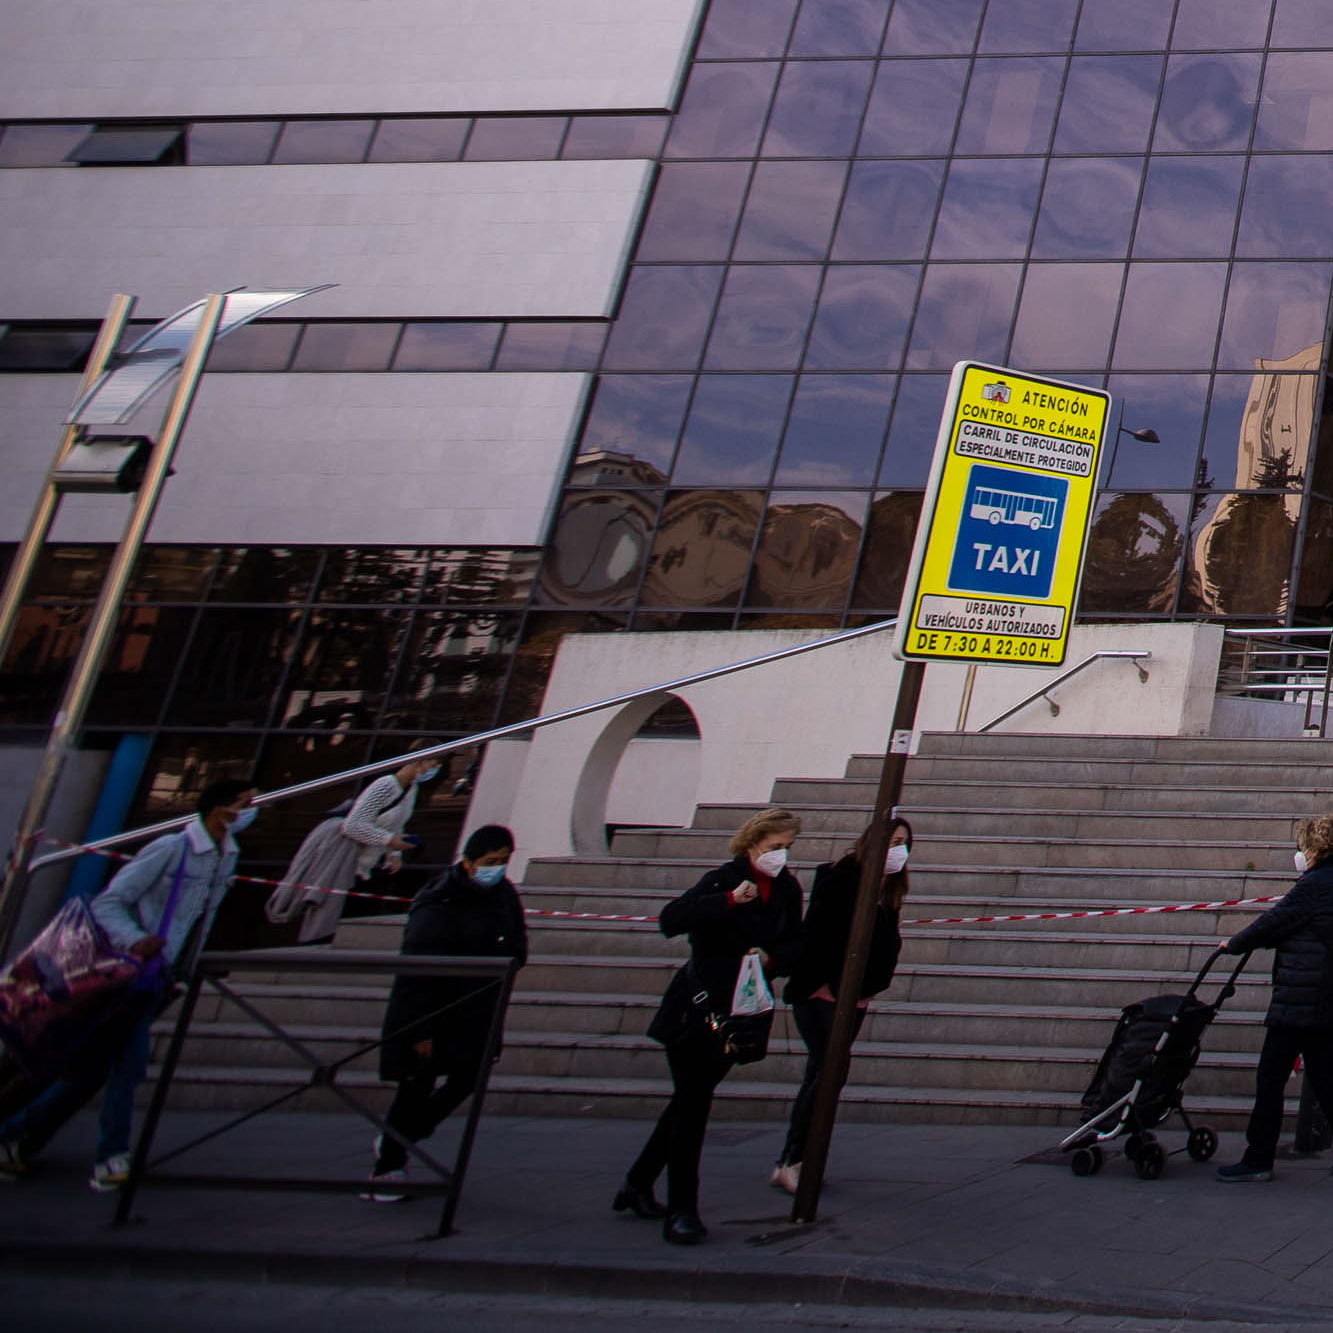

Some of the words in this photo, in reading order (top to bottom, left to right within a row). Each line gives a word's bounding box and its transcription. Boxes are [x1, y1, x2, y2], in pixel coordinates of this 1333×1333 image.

[1022, 391, 1088, 416] ATENCIÓN
[962, 404, 1018, 426] CONTROL
[1022, 416, 1045, 431] POR
[1049, 419, 1096, 441] CÁMARA
[963, 424, 1001, 441] CARRIL
[1005, 432, 1018, 444] DE
[1021, 435, 1091, 458] CIRCULACIÓN
[959, 441, 1035, 464] ESPECIALMENTE
[1037, 454, 1087, 473] PROTEGIDO
[973, 543, 1041, 576] TAXI
[925, 612, 983, 630] VEHÍCULOS
[986, 619, 1057, 636] AUTORIZADOS
[965, 601, 1016, 617] URBANOS
[1018, 606, 1026, 619] Y
[916, 633, 939, 650] DE
[943, 635, 977, 653] 7:30
[981, 638, 991, 654] A
[995, 639, 1037, 657] 22:00
